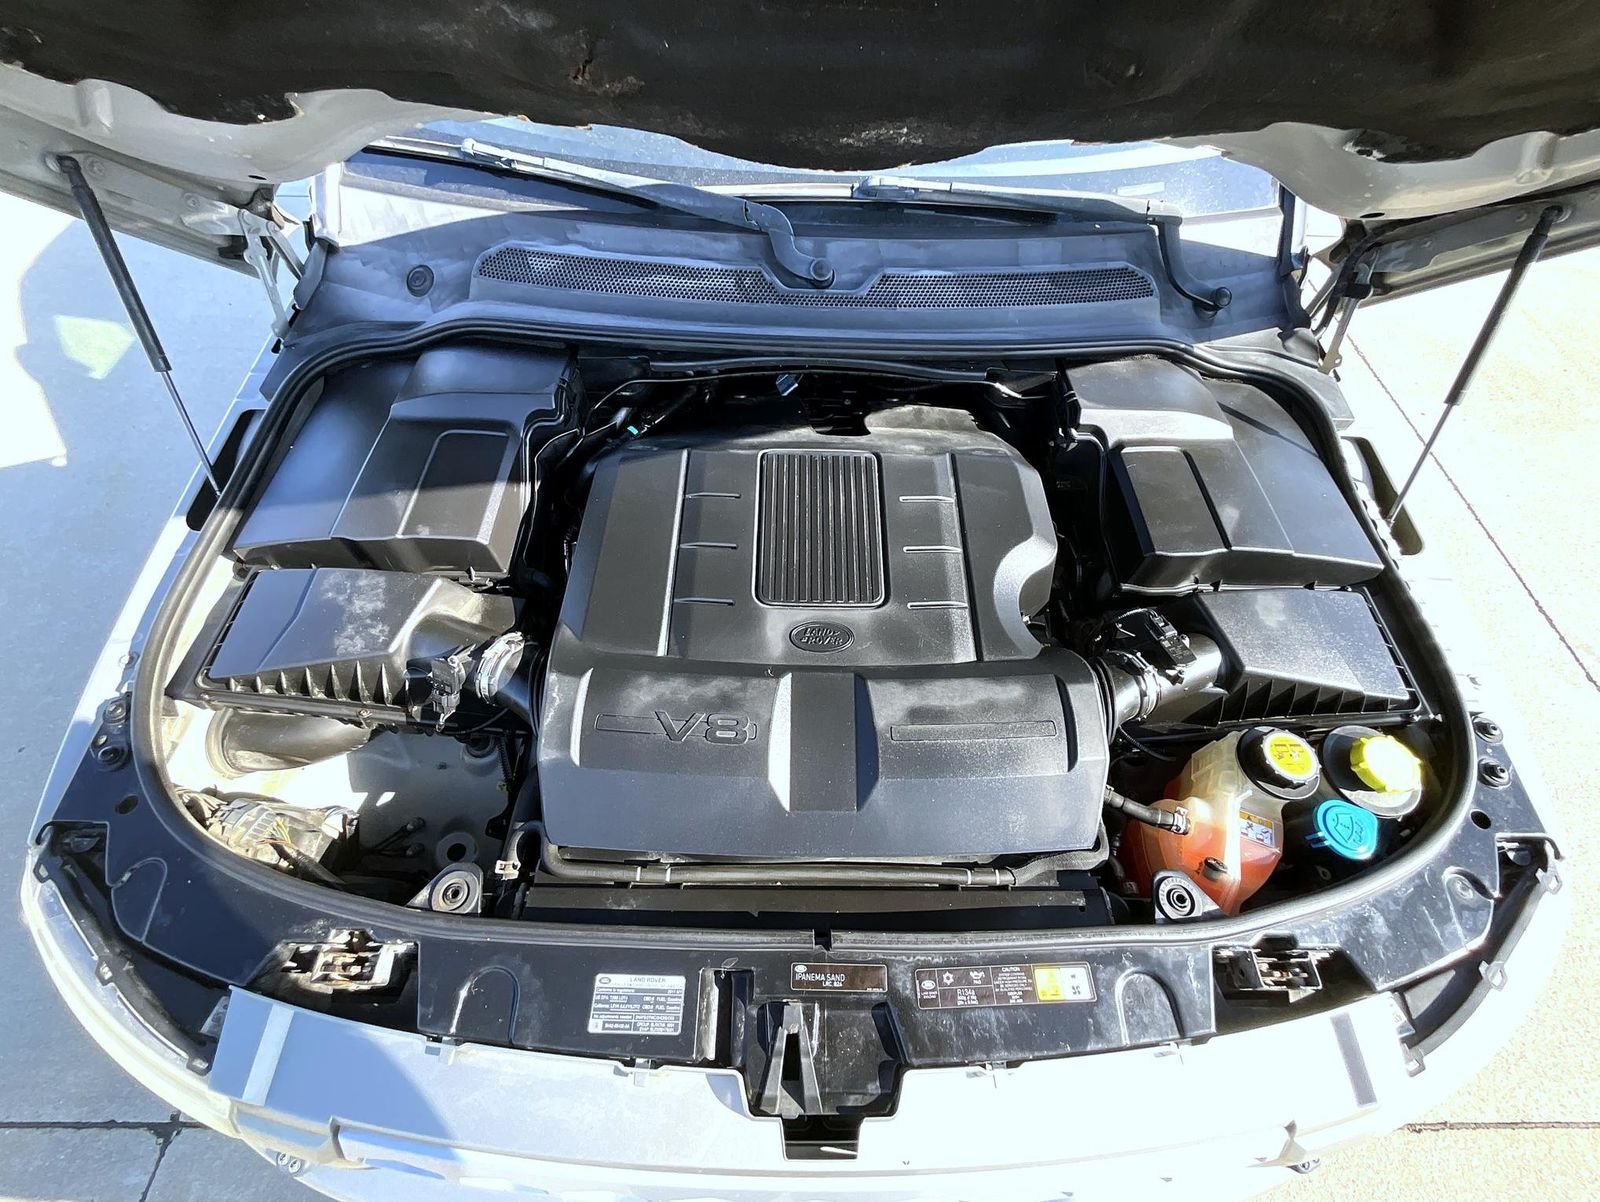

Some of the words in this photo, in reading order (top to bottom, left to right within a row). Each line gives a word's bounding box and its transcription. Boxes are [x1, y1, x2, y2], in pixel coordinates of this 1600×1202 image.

[654, 710, 750, 746] V8
[646, 976, 667, 984] ROVER
[795, 973, 826, 982] IPANEMA
[826, 973, 846, 982] SAND
